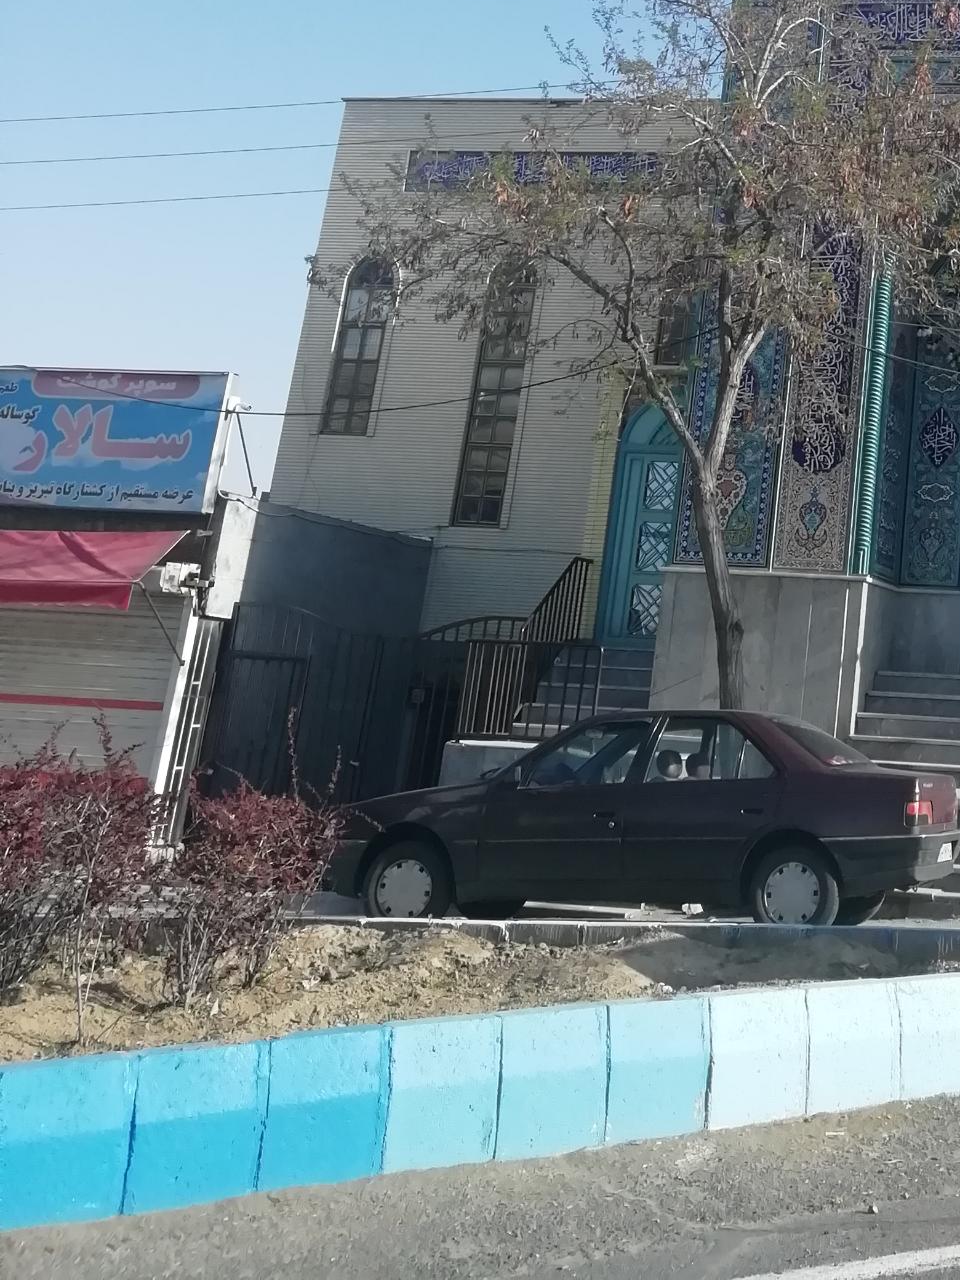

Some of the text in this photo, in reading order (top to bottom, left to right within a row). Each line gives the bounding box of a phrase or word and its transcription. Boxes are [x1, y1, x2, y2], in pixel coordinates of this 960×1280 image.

[57, 373, 176, 397] سوپر گوشت
[13, 404, 192, 473] سالار
[15, 485, 24, 498] و
[25, 481, 54, 498] تبریز
[106, 485, 120, 502] از
[120, 484, 159, 502] مستقیم
[161, 487, 194, 504] عرضه
